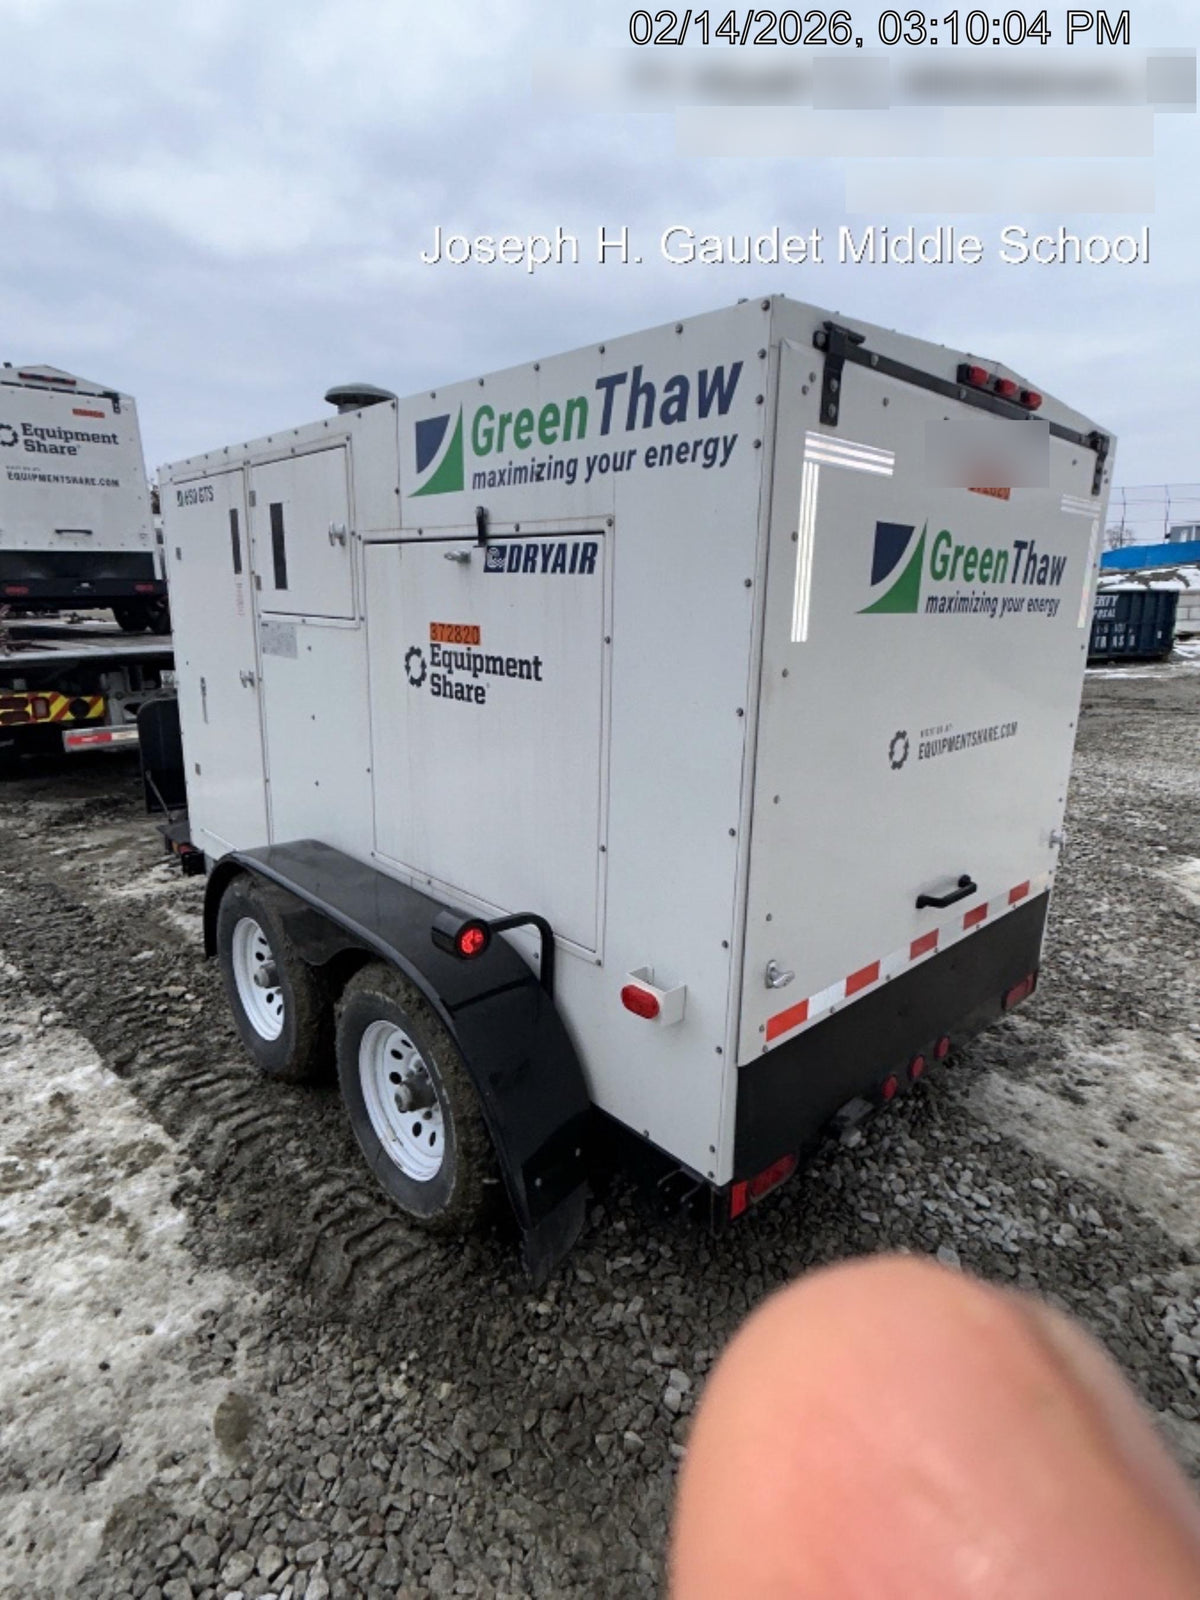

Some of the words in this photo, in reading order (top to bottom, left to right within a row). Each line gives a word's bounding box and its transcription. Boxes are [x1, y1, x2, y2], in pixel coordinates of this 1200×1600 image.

[20, 422, 119, 445] Equipment
[23, 438, 78, 456] Share
[472, 454, 578, 490] maximizing
[584, 448, 637, 483] your
[644, 433, 739, 470] energy
[7, 471, 120, 488] EQUIPMENTSHARE.COM
[506, 541, 599, 575] DRYAIR
[925, 590, 998, 618] maximizing
[998, 596, 1026, 619] your
[1027, 598, 1061, 618] energy
[430, 623, 481, 645] 372820
[429, 643, 543, 682] Equipment
[430, 673, 487, 705] Share
[918, 721, 1018, 760] EQUIPMENTSHARE.COM
